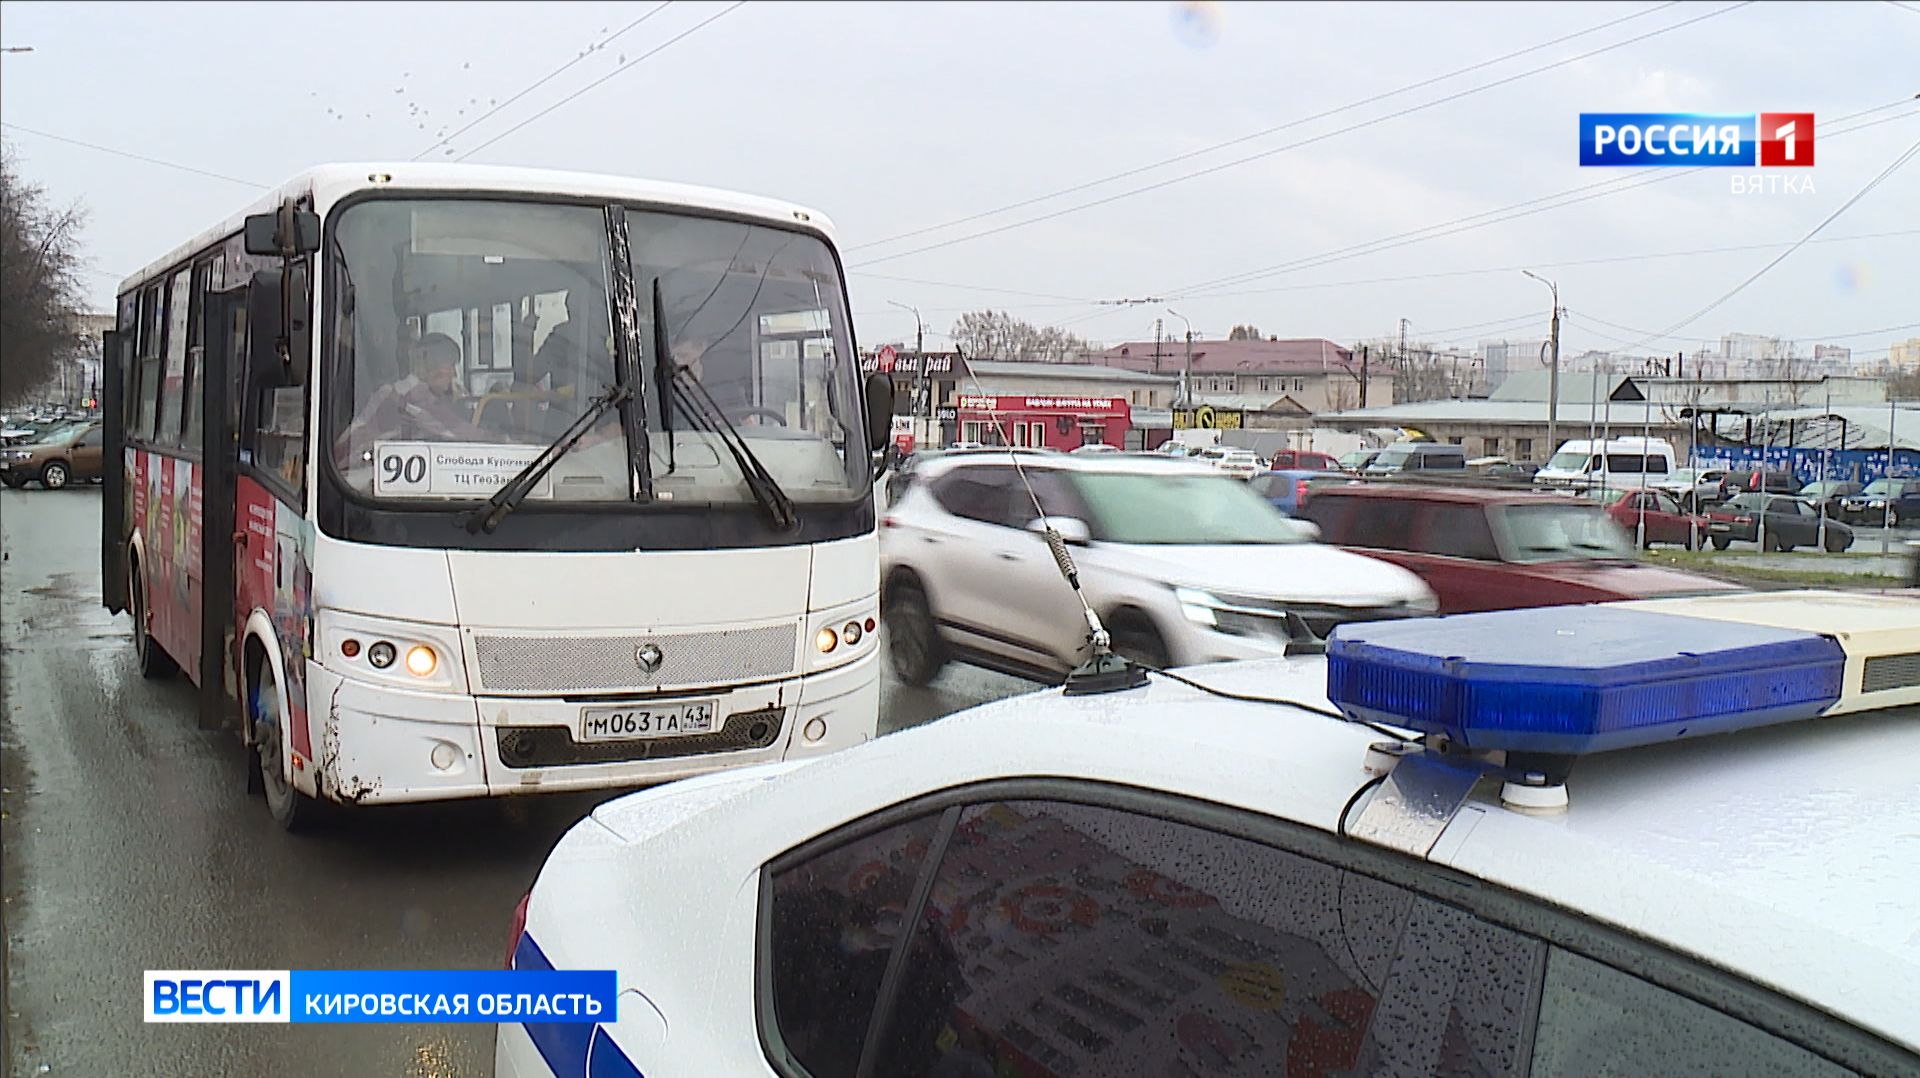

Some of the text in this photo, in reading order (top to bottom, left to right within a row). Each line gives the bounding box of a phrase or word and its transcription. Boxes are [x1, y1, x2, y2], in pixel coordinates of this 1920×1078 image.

[382, 453, 426, 484] 90
[436, 454, 484, 467] Слобода
[454, 474, 471, 485] ТЦ
[593, 705, 704, 735] М063ТА 43
